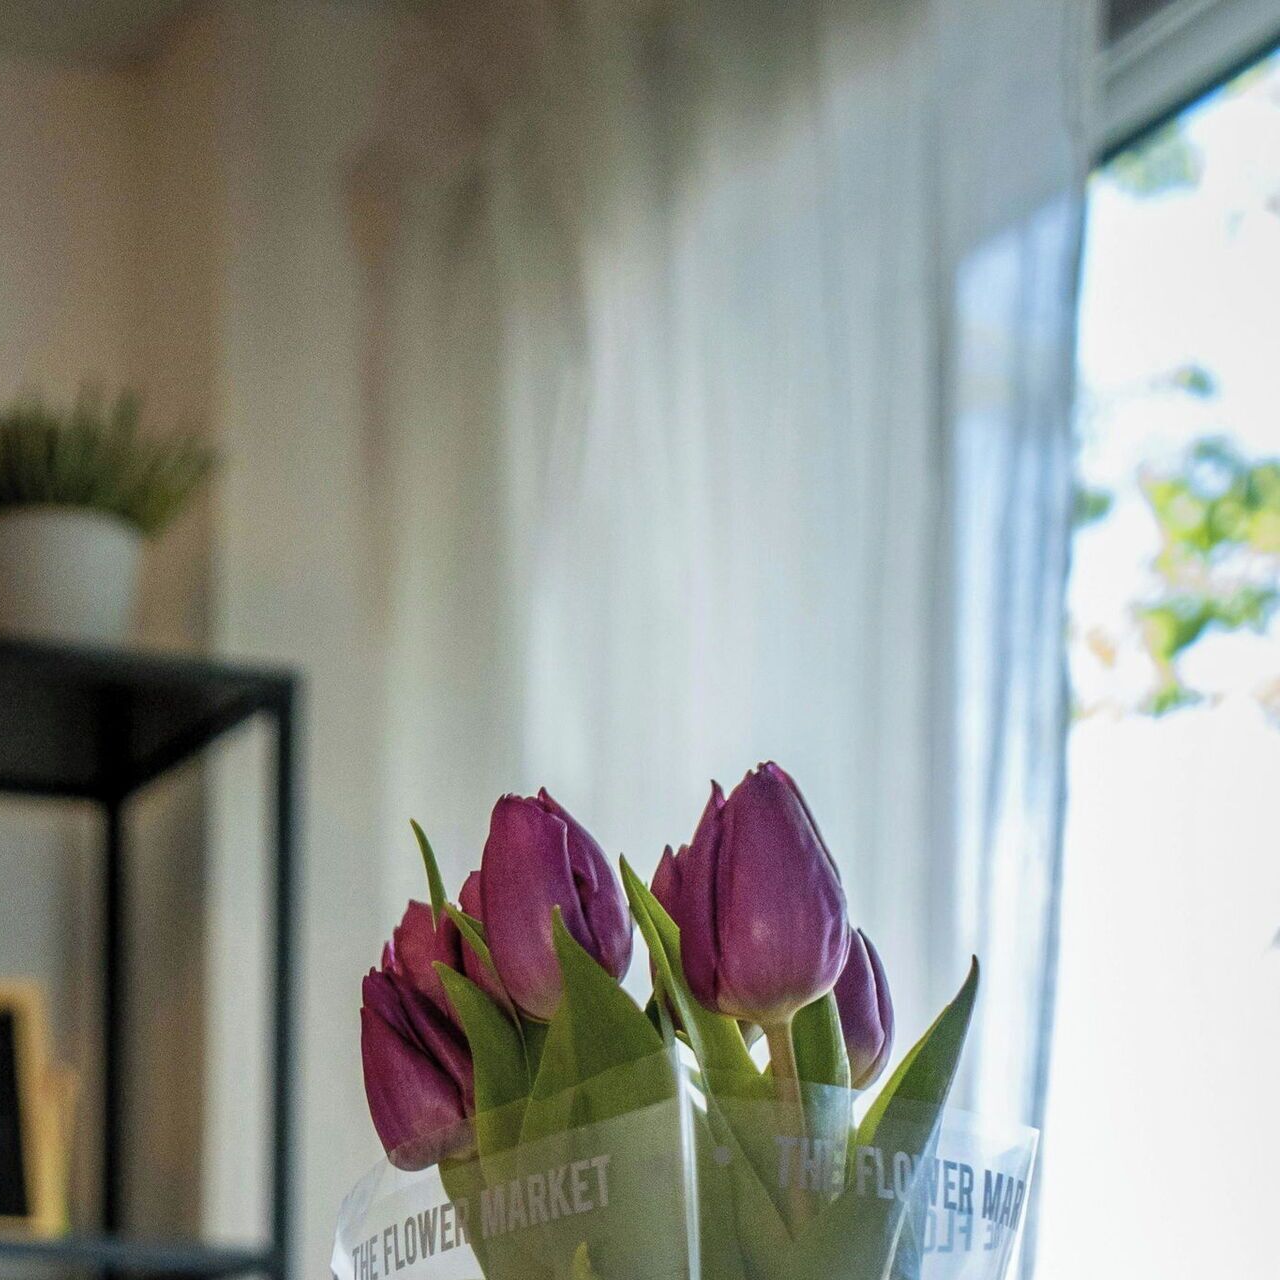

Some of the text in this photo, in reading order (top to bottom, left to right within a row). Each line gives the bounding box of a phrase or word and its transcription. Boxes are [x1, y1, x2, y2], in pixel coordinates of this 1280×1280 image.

[774, 1135, 845, 1195] THE
[383, 1199, 471, 1276] FLOWER
[480, 1154, 612, 1239] MARKET
